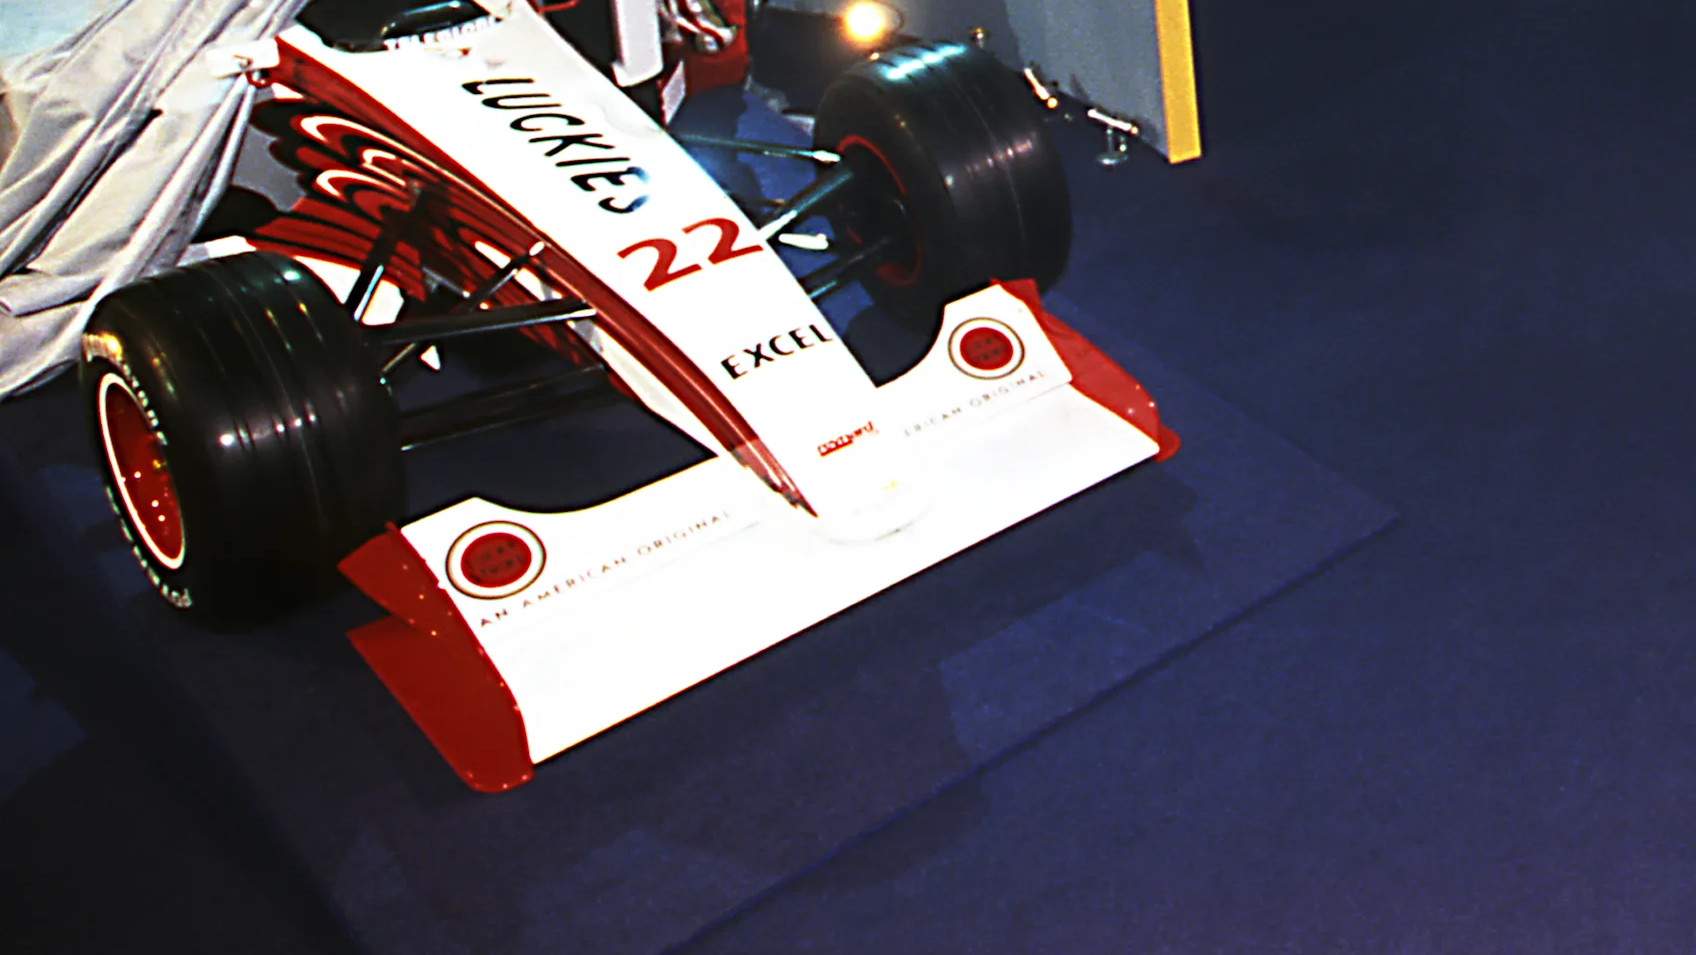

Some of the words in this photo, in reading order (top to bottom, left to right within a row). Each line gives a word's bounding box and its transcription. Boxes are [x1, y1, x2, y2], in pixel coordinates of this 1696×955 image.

[460, 77, 651, 214] LUCKIES
[616, 217, 764, 293] 22
[720, 323, 834, 380] EXCEL
